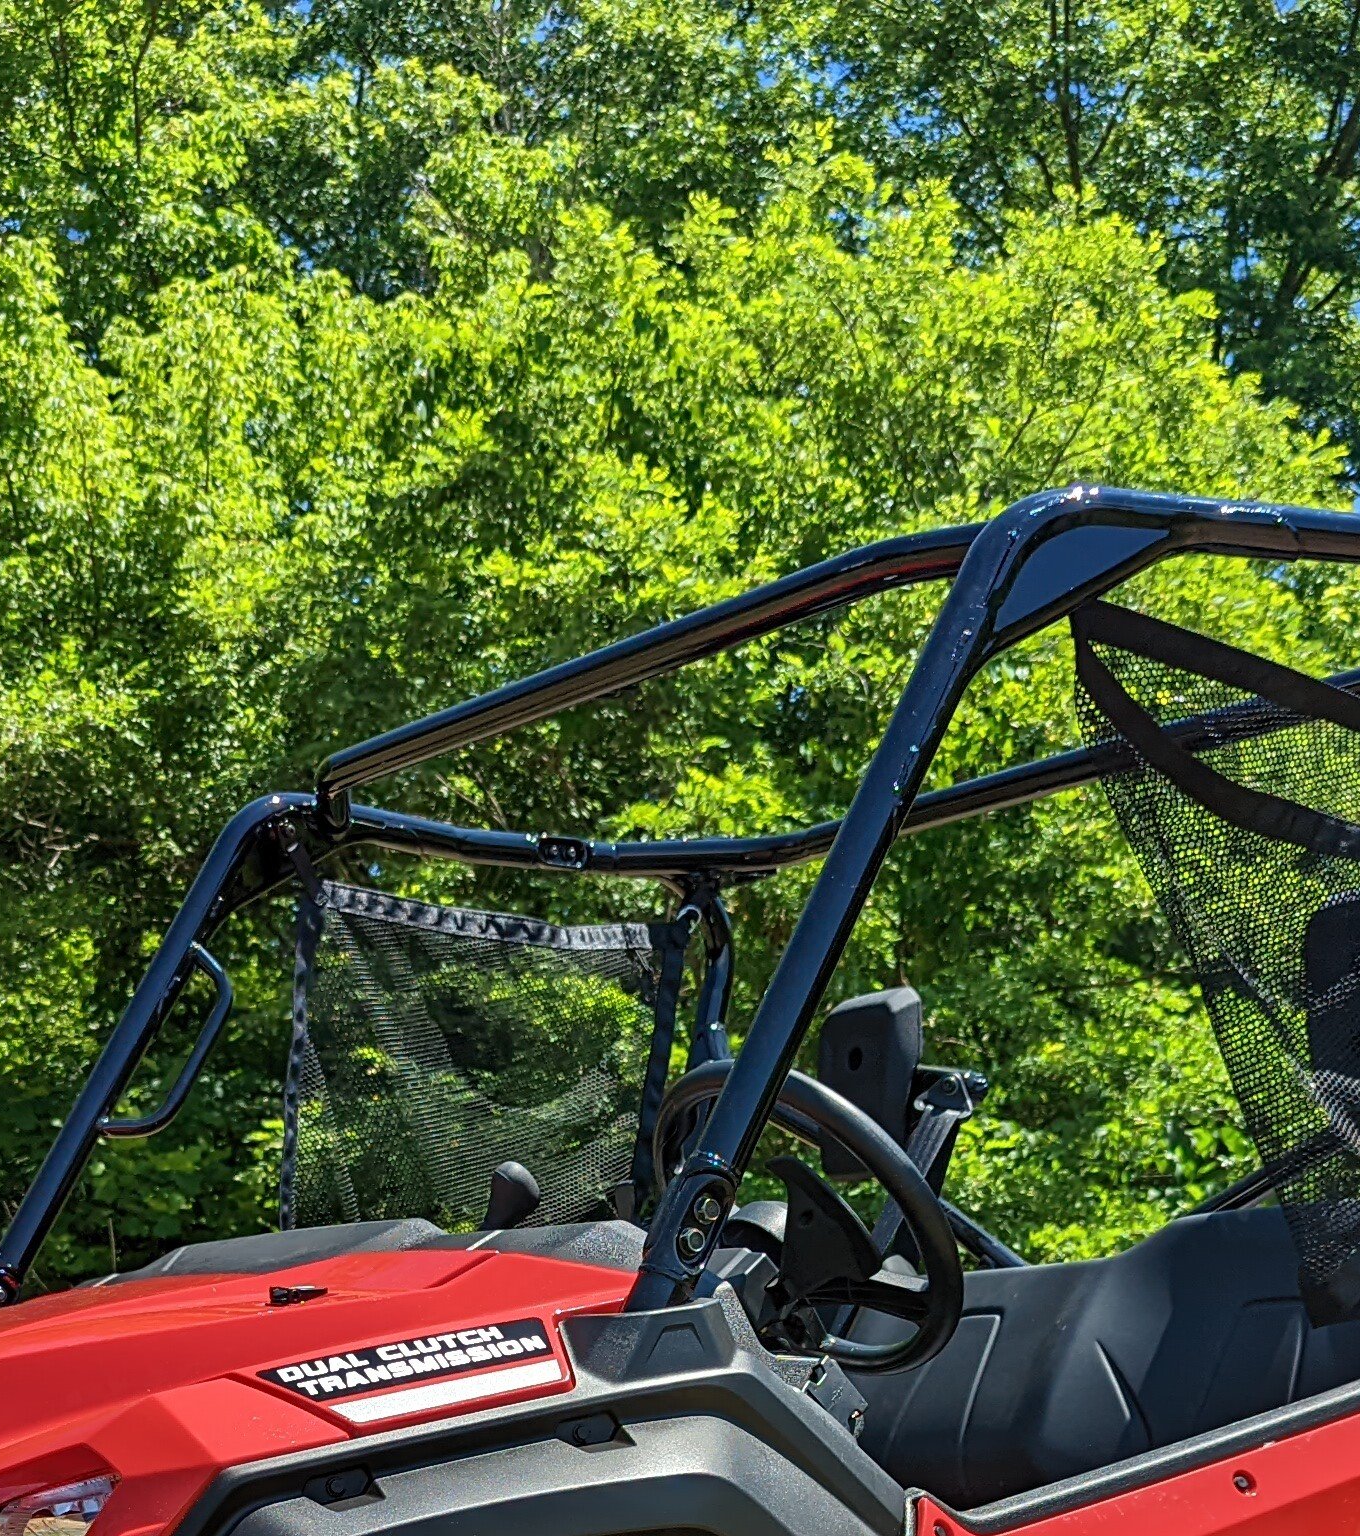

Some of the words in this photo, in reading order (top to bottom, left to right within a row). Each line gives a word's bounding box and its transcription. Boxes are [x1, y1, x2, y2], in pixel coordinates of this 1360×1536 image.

[276, 1352, 370, 1383] DUAL
[376, 1326, 504, 1361] CLUTCH
[297, 1335, 547, 1396] TRANSMISSION
